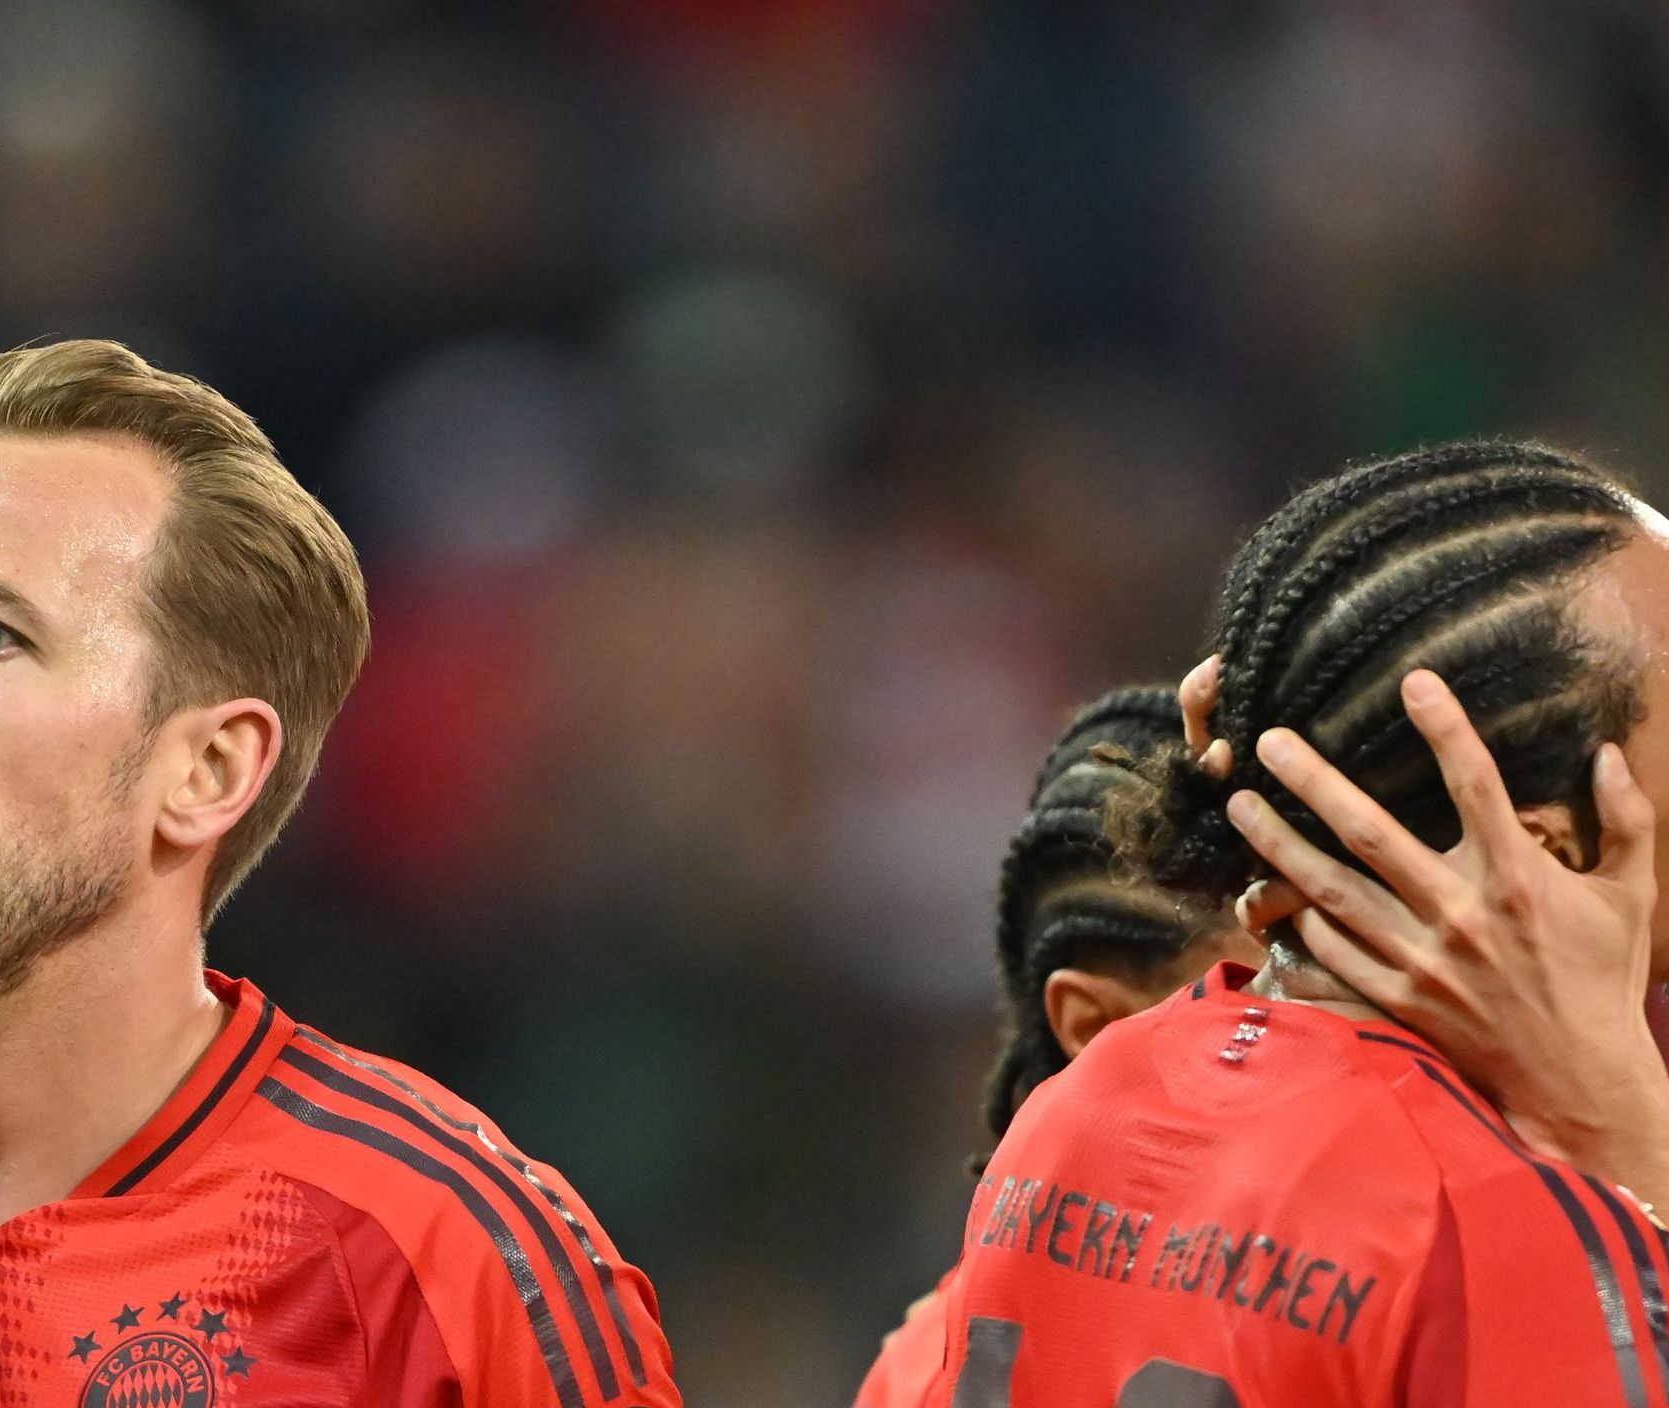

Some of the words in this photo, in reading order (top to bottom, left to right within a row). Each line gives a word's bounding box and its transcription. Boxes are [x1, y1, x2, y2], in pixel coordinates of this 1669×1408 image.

[981, 1173, 1154, 1284] BAYERN
[96, 1357, 124, 1388] FC
[130, 1341, 205, 1394] BAYERN
